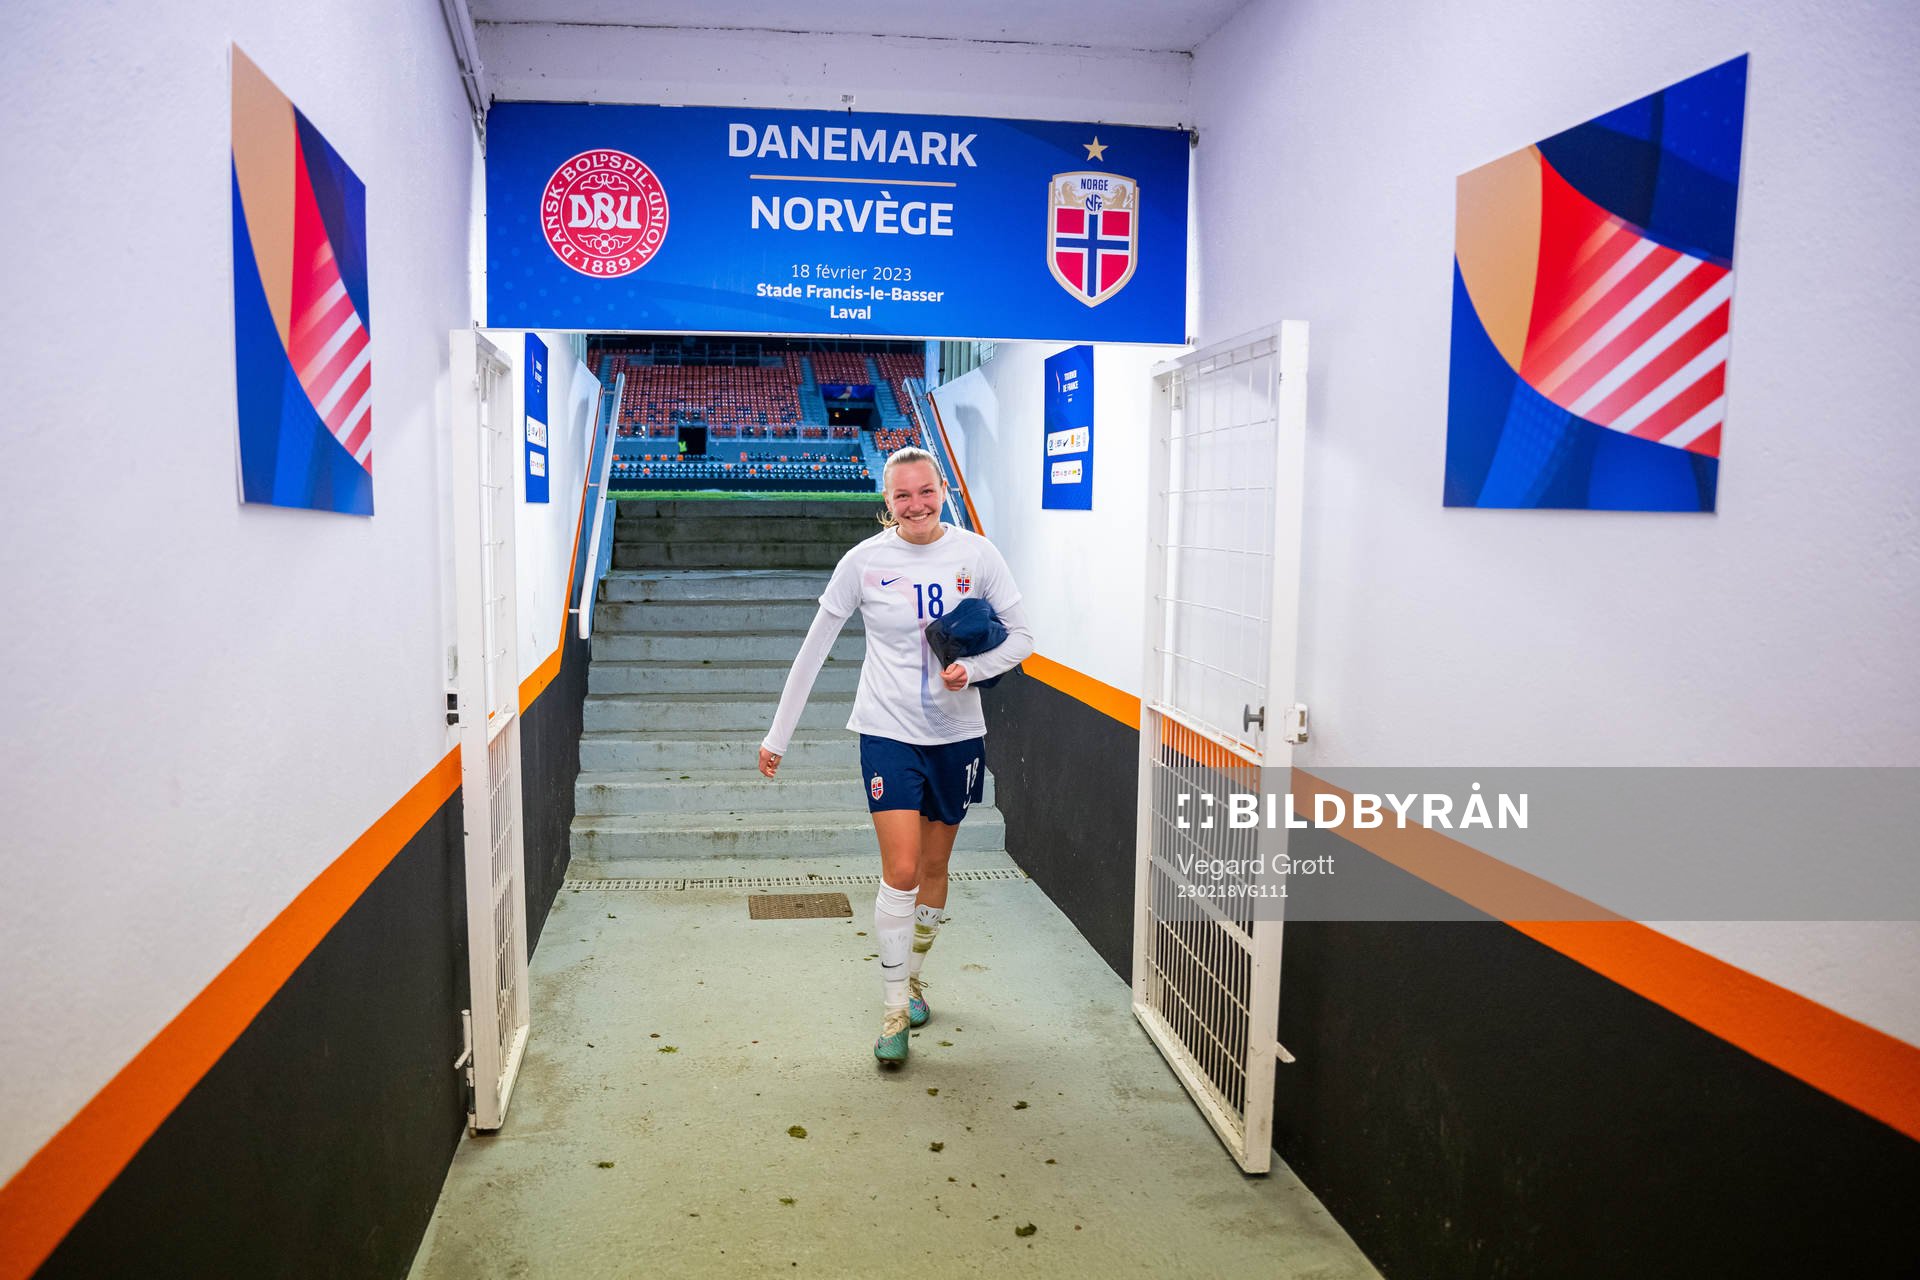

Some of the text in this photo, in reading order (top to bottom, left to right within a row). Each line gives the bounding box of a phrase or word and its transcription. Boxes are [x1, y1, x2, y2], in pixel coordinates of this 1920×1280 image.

[728, 123, 978, 167] DANEMARK
[1080, 178, 1109, 191] NORGE
[545, 184, 576, 259] DANSK
[567, 192, 642, 231] DBU
[751, 190, 954, 236] NORVÈGE
[580, 257, 631, 274] 1889
[791, 263, 912, 282] 18 février 2023
[756, 283, 945, 302] Stade Francis-le-Basser
[830, 305, 872, 320] Laval
[913, 583, 944, 619] 18
